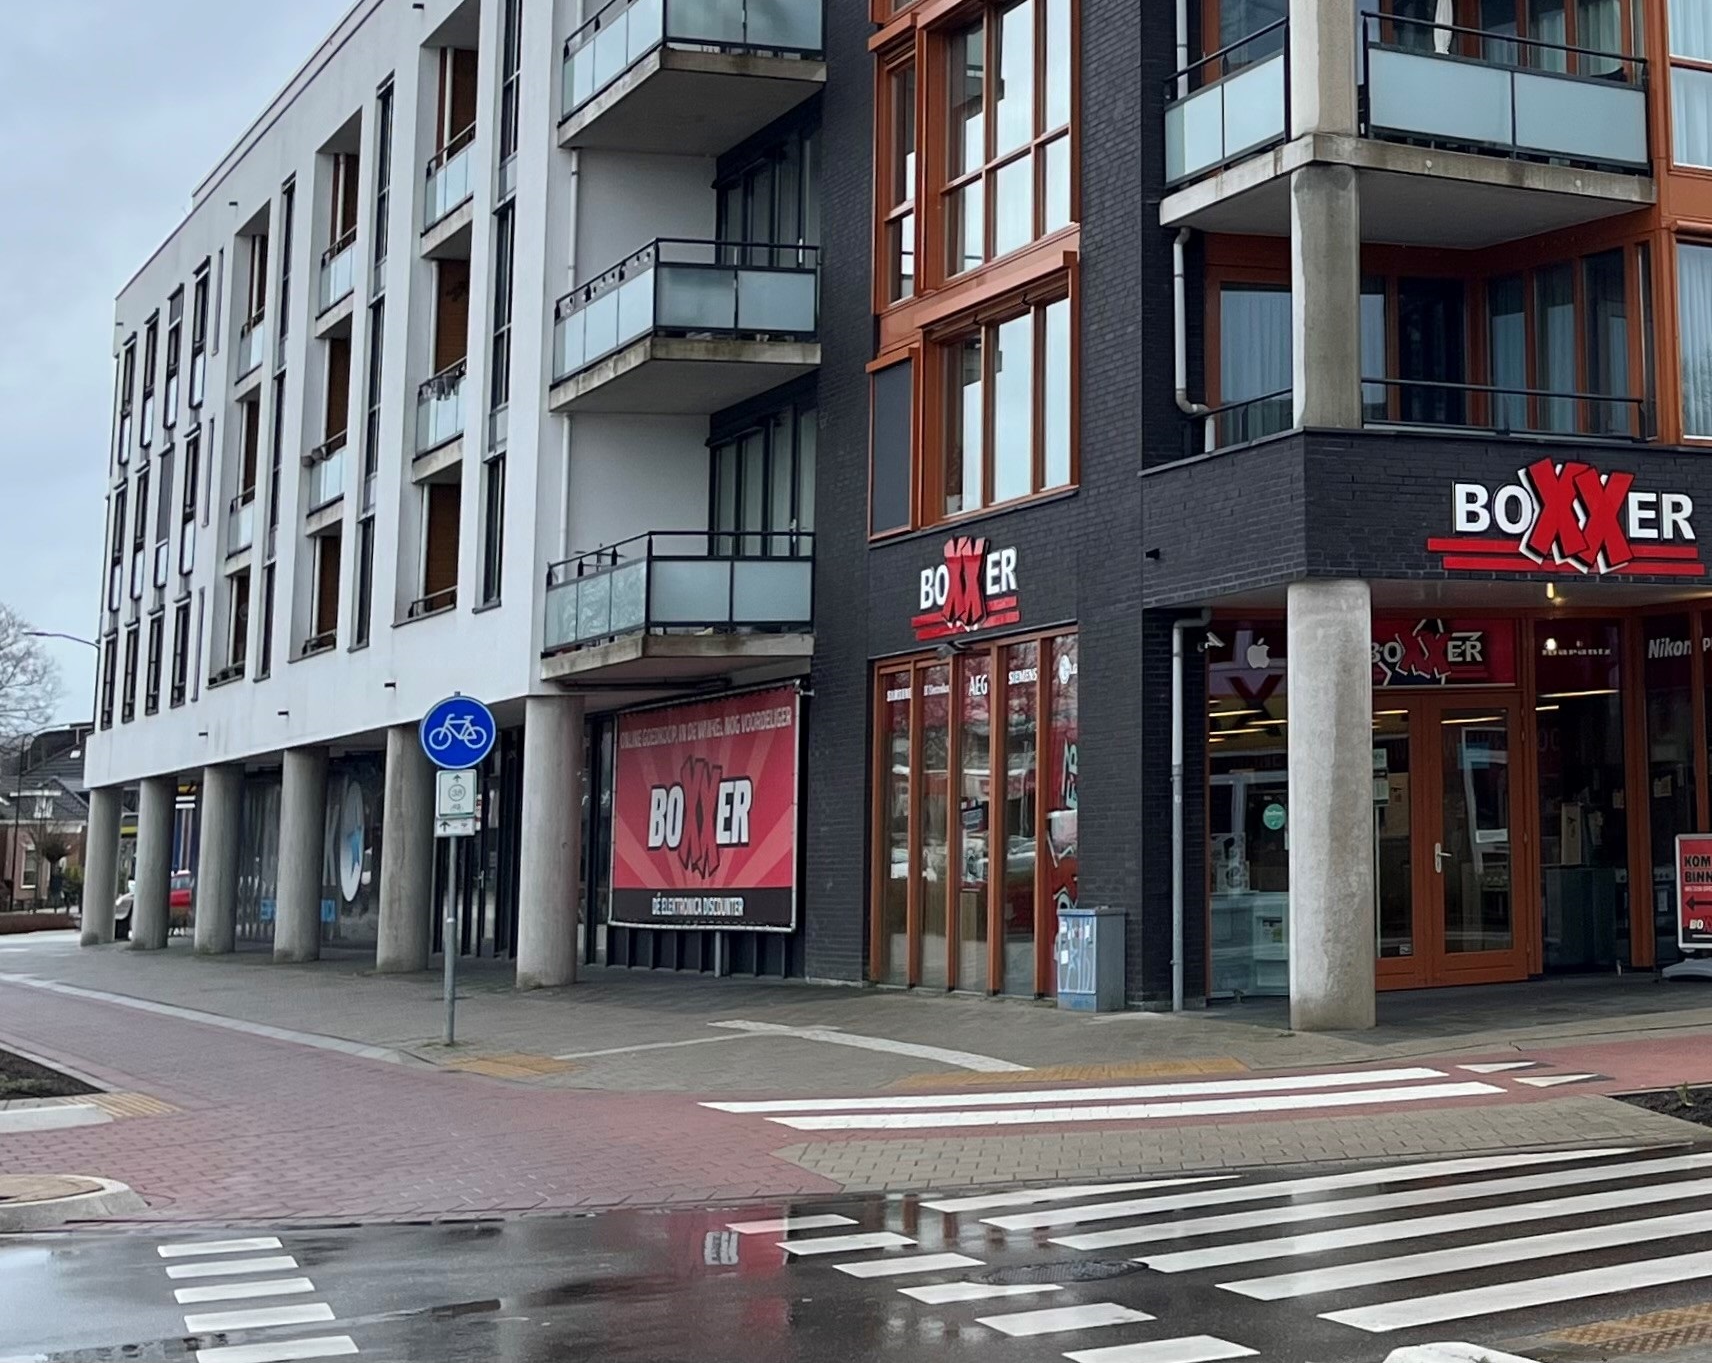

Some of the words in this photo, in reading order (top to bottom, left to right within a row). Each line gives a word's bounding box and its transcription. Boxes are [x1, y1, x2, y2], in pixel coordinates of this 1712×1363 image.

[1453, 457, 1697, 575] BOXXER
[919, 536, 1018, 632] BOXXER
[1648, 637, 1692, 659] Nikon
[968, 674, 988, 697] AEG
[1684, 855, 1711, 868] KOM
